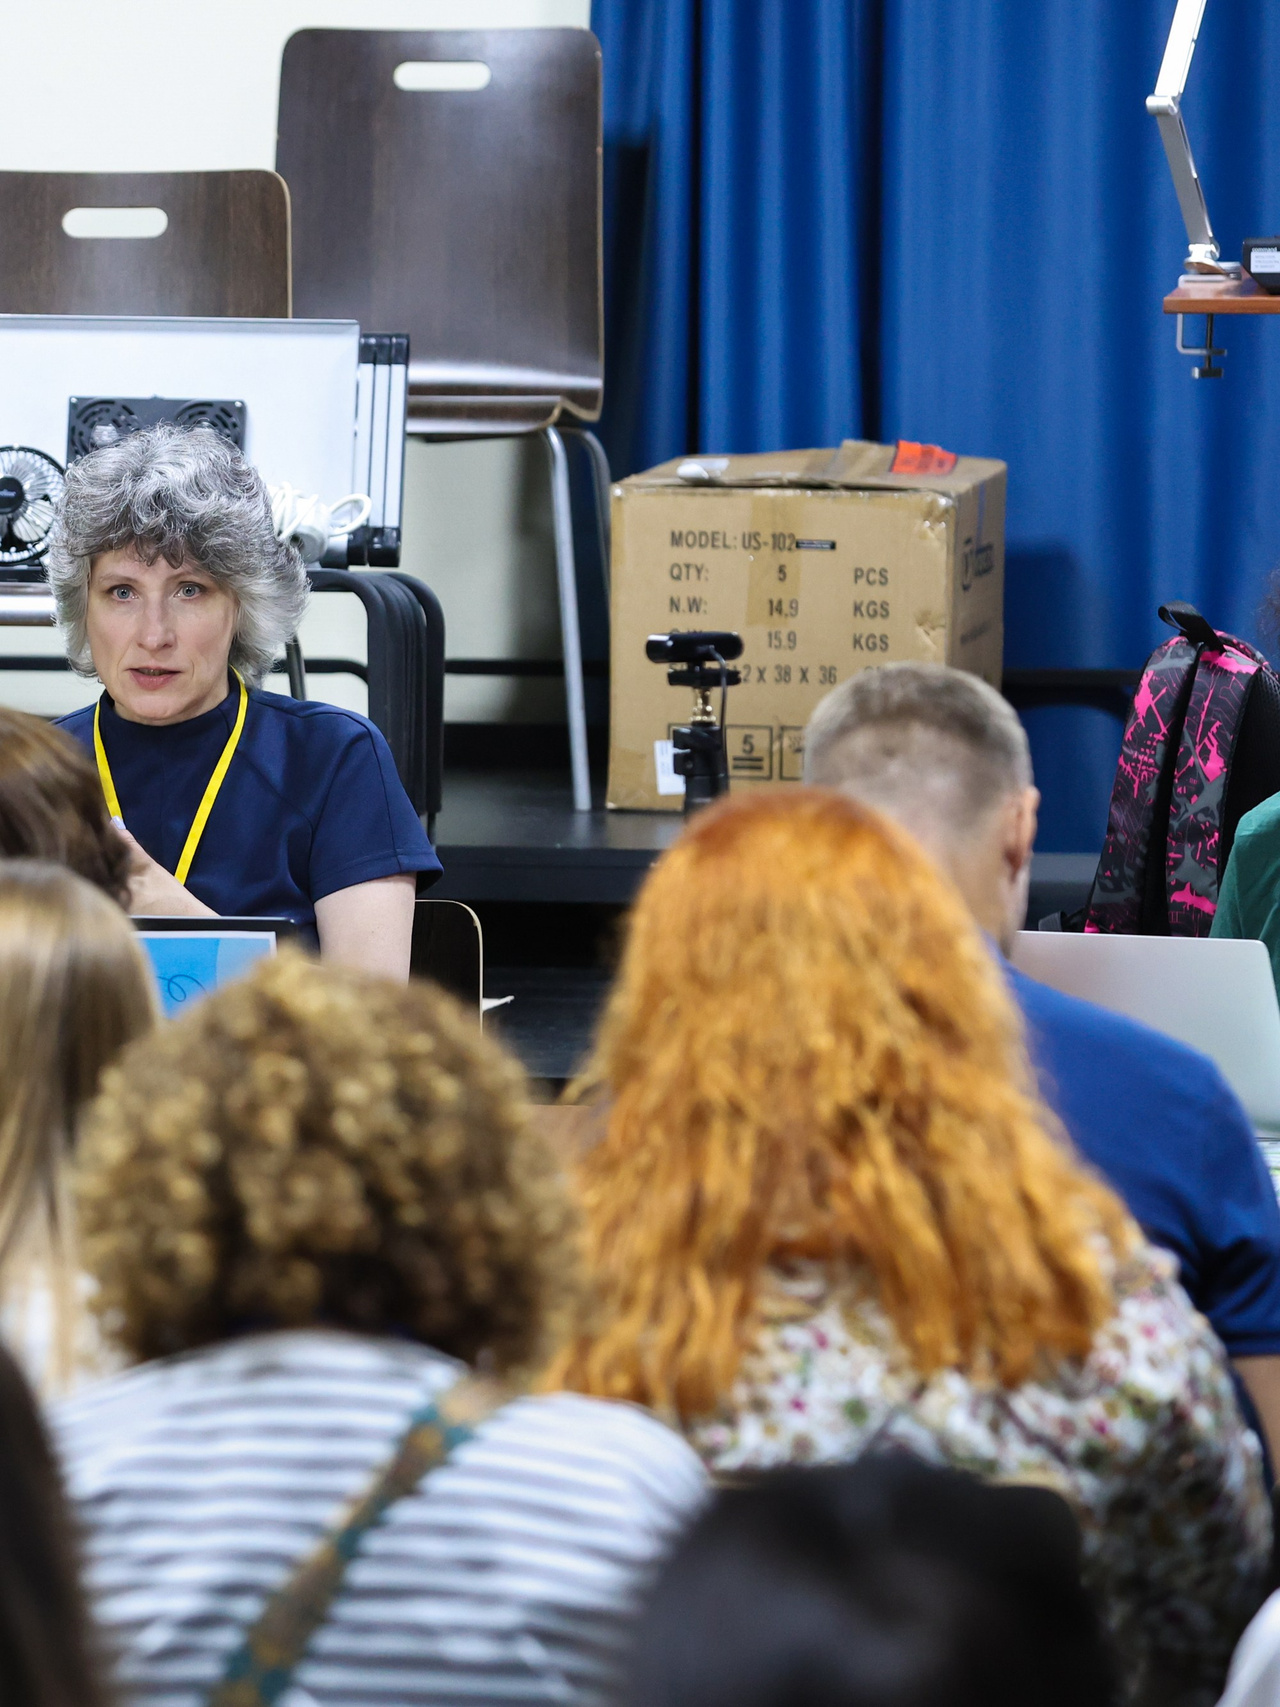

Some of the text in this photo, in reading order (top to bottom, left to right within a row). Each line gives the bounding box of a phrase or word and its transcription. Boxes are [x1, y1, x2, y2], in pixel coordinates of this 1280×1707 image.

[670, 530, 737, 549] MODEL:
[742, 532, 796, 552] US-102
[669, 563, 889, 586] QTY: 5 PCS
[668, 596, 890, 618] N.W: 14.9 KGS
[768, 631, 889, 652] 15.9 KGS
[775, 665, 791, 683] 38
[819, 666, 837, 684] 36
[742, 734, 755, 754] 5
